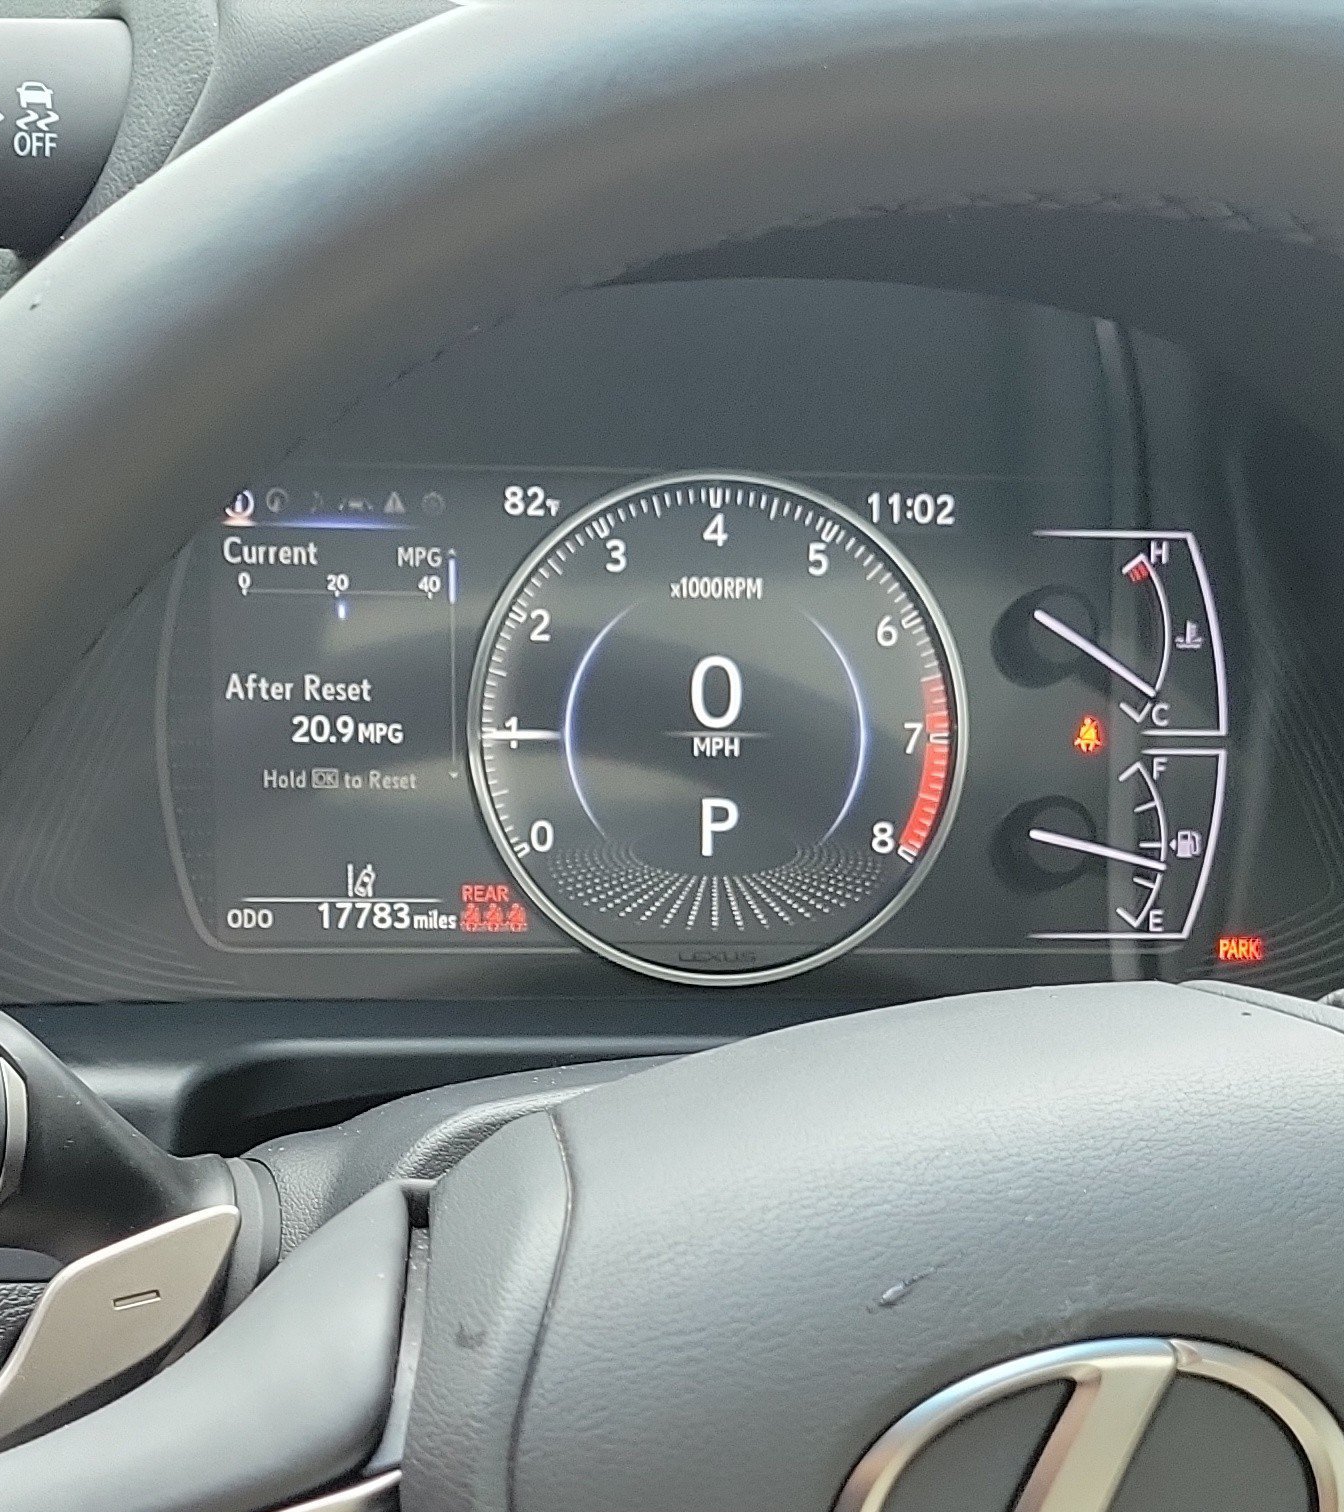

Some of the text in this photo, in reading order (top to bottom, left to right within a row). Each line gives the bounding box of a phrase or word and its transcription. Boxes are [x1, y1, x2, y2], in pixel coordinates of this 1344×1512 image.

[13, 131, 59, 158] OFF
[867, 494, 955, 526] 11:02
[702, 513, 729, 547] 4
[222, 536, 444, 569] Current MPG
[604, 539, 830, 576] 3 5
[1150, 541, 1170, 564] H
[237, 572, 442, 595] 0 20 40
[669, 576, 764, 601] x1000RPM
[529, 608, 899, 648] 2 6
[224, 673, 373, 703] After Reset
[689, 654, 744, 730] 0
[291, 714, 404, 745] 20.9 MPG
[1150, 704, 1170, 727] C
[692, 735, 741, 759] MPH
[903, 722, 923, 756] 7
[263, 769, 417, 791] Hold OK to Reset
[1152, 757, 1169, 780] F
[529, 819, 897, 855] 0 8
[700, 797, 740, 857] P
[461, 885, 510, 902] REAR
[227, 902, 457, 931] ODO 17783 miles
[1148, 909, 1165, 932] E
[1218, 937, 1262, 961] PARK
